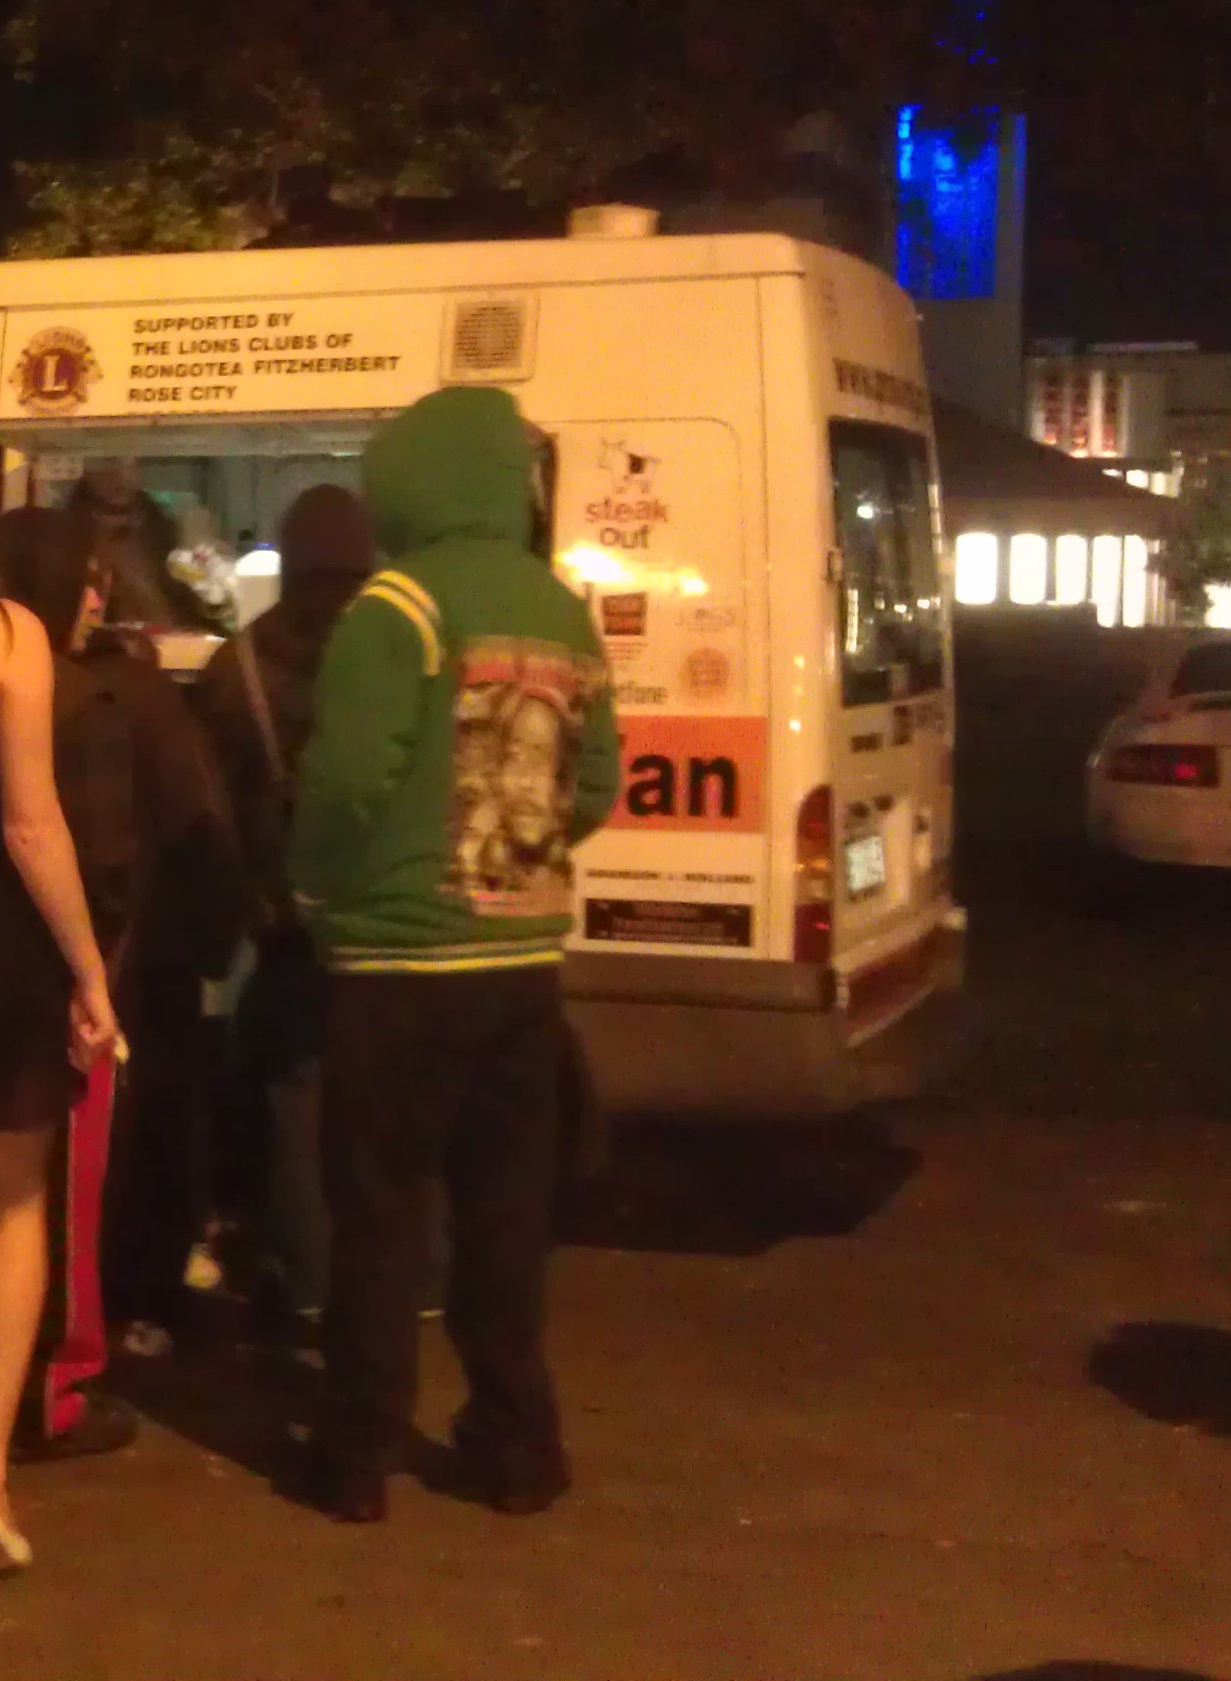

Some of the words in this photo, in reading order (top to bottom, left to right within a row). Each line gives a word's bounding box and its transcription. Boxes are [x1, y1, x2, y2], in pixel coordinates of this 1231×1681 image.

[133, 313, 259, 334] SUPPORTED
[266, 312, 295, 329] BY
[131, 341, 170, 357] THE
[178, 338, 241, 355] LIONS
[248, 334, 318, 352] CLUBS
[326, 333, 354, 349] OF
[41, 355, 69, 392] L
[130, 361, 244, 380] RONGOTEA
[253, 356, 402, 375] FITZHERBERT
[128, 386, 182, 402] ROSE
[190, 385, 238, 402] CITY
[619, 733, 740, 818] an
